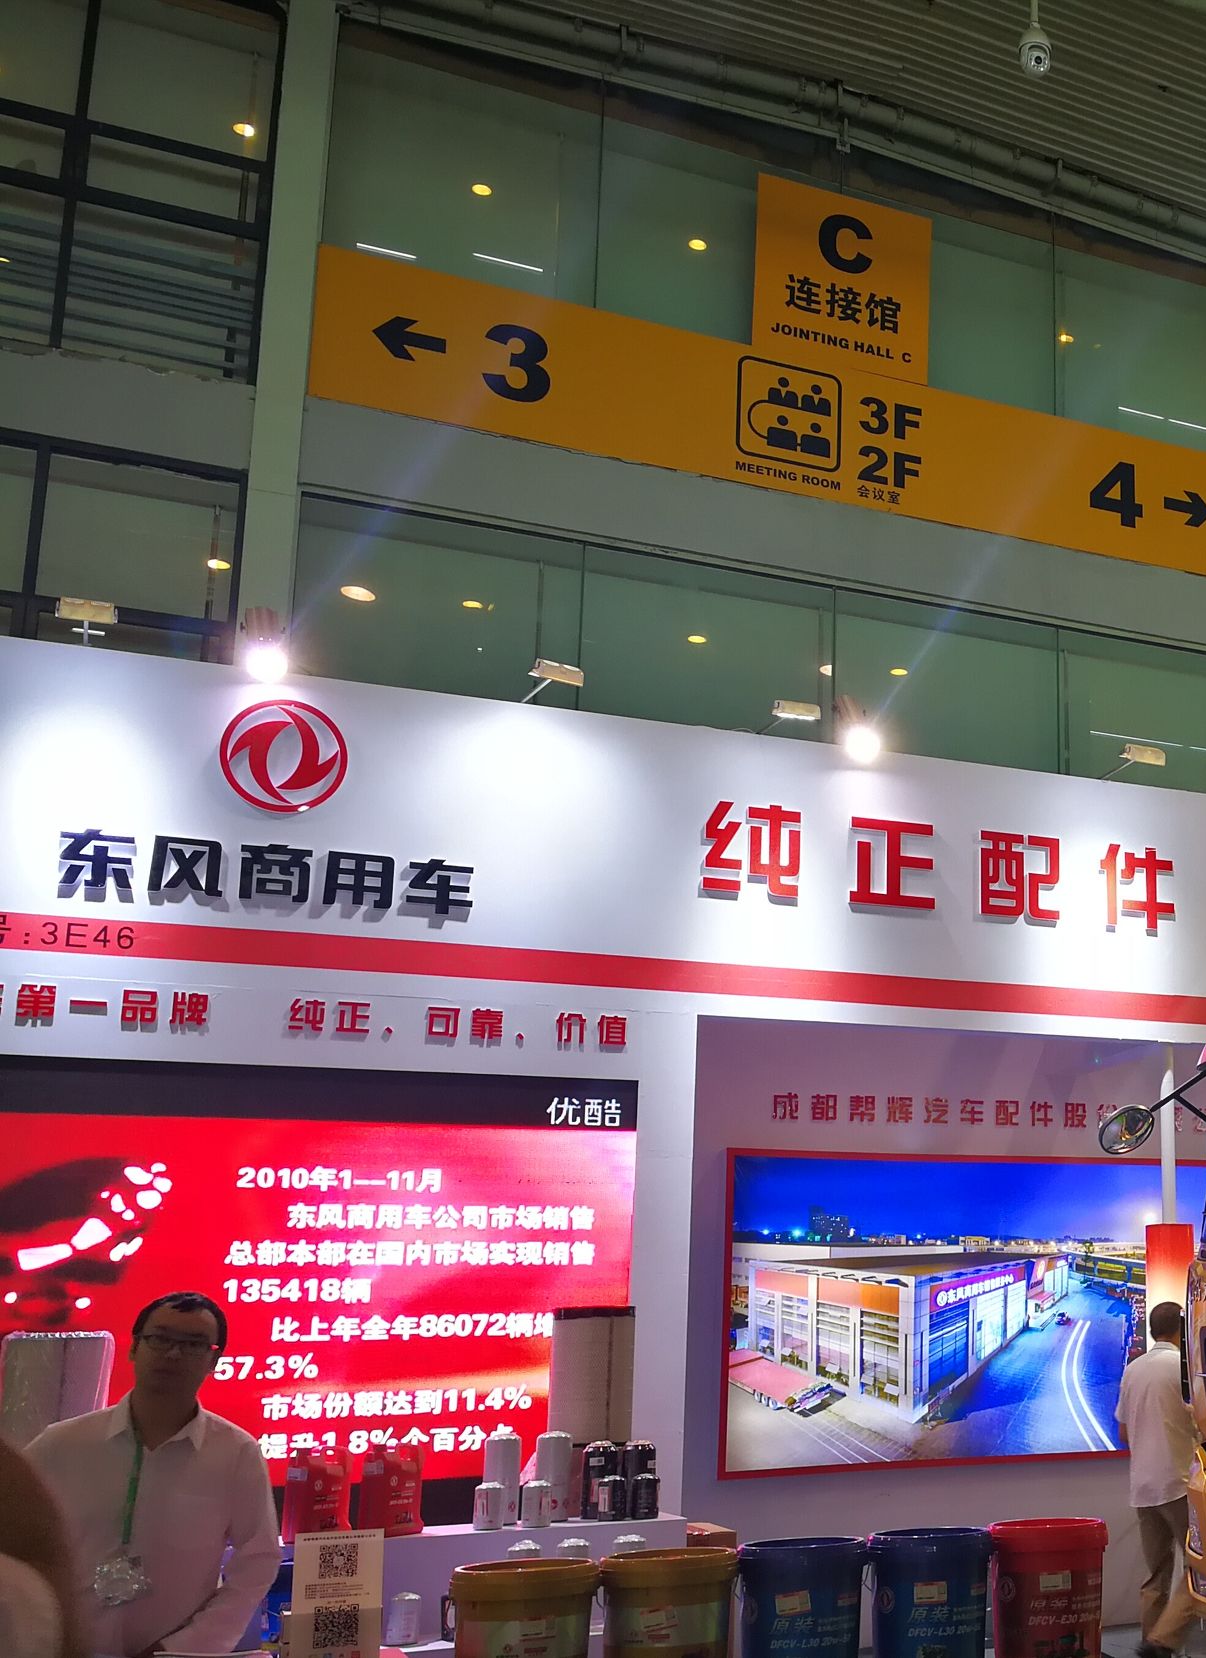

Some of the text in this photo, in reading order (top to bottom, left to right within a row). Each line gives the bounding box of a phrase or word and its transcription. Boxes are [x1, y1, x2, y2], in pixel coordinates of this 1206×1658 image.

[818, 214, 873, 274] C
[785, 274, 902, 334] 连接馆
[771, 322, 912, 363] JOINTING HALL C
[481, 322, 551, 403] 3
[859, 396, 922, 440] 3F
[735, 460, 841, 491] MEETING ROOM
[857, 445, 922, 489] 2F
[857, 485, 900, 505] 会议室
[1089, 462, 1144, 528] 4
[58, 829, 474, 916] 东风商用车
[701, 800, 1176, 931] 纯正配件
[0, 984, 209, 1027] 第一品牌
[547, 1096, 622, 1128] 优酷
[287, 1203, 594, 1231] 东风商用车公司市场销售
[224, 1239, 594, 1267] 总部本部在国内市场实现销售
[222, 1278, 372, 1304] 135418辆
[213, 1352, 319, 1381] 57.3%
[261, 1384, 532, 1421] 市场份额达到11.4%
[258, 1423, 514, 1461] 提升18%个百分
[770, 1637, 820, 1649] DFCV-L30
